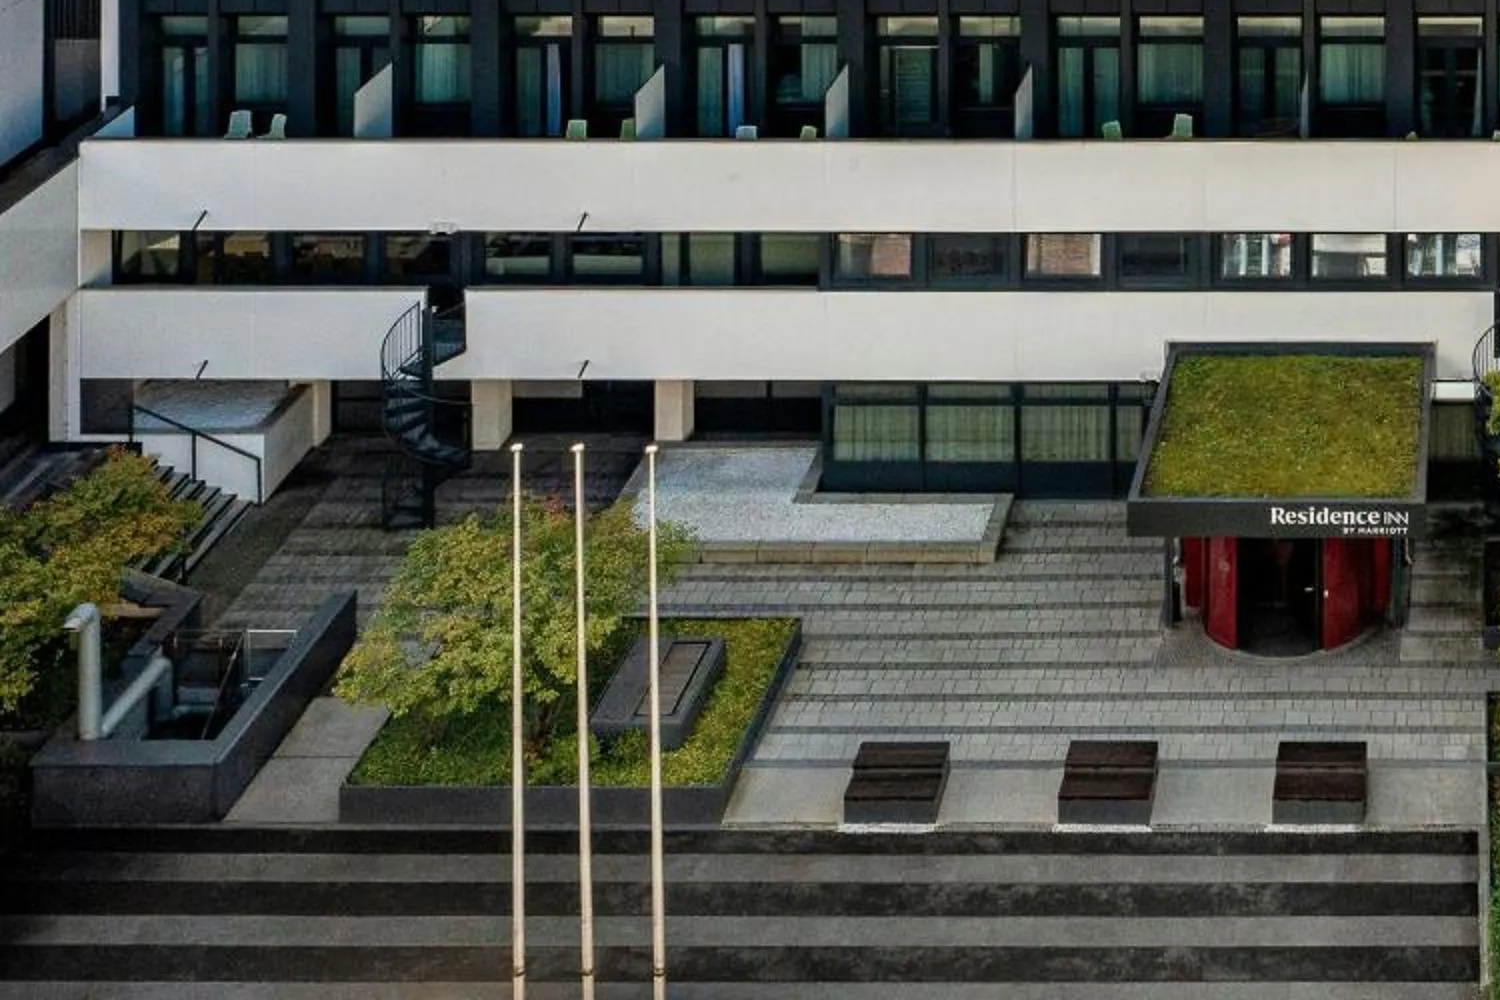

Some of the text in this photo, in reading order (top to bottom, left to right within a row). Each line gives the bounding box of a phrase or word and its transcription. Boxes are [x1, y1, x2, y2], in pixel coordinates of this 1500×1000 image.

[1270, 506, 1410, 526] Residence INN
[1357, 527, 1410, 535] MARRIOTT
